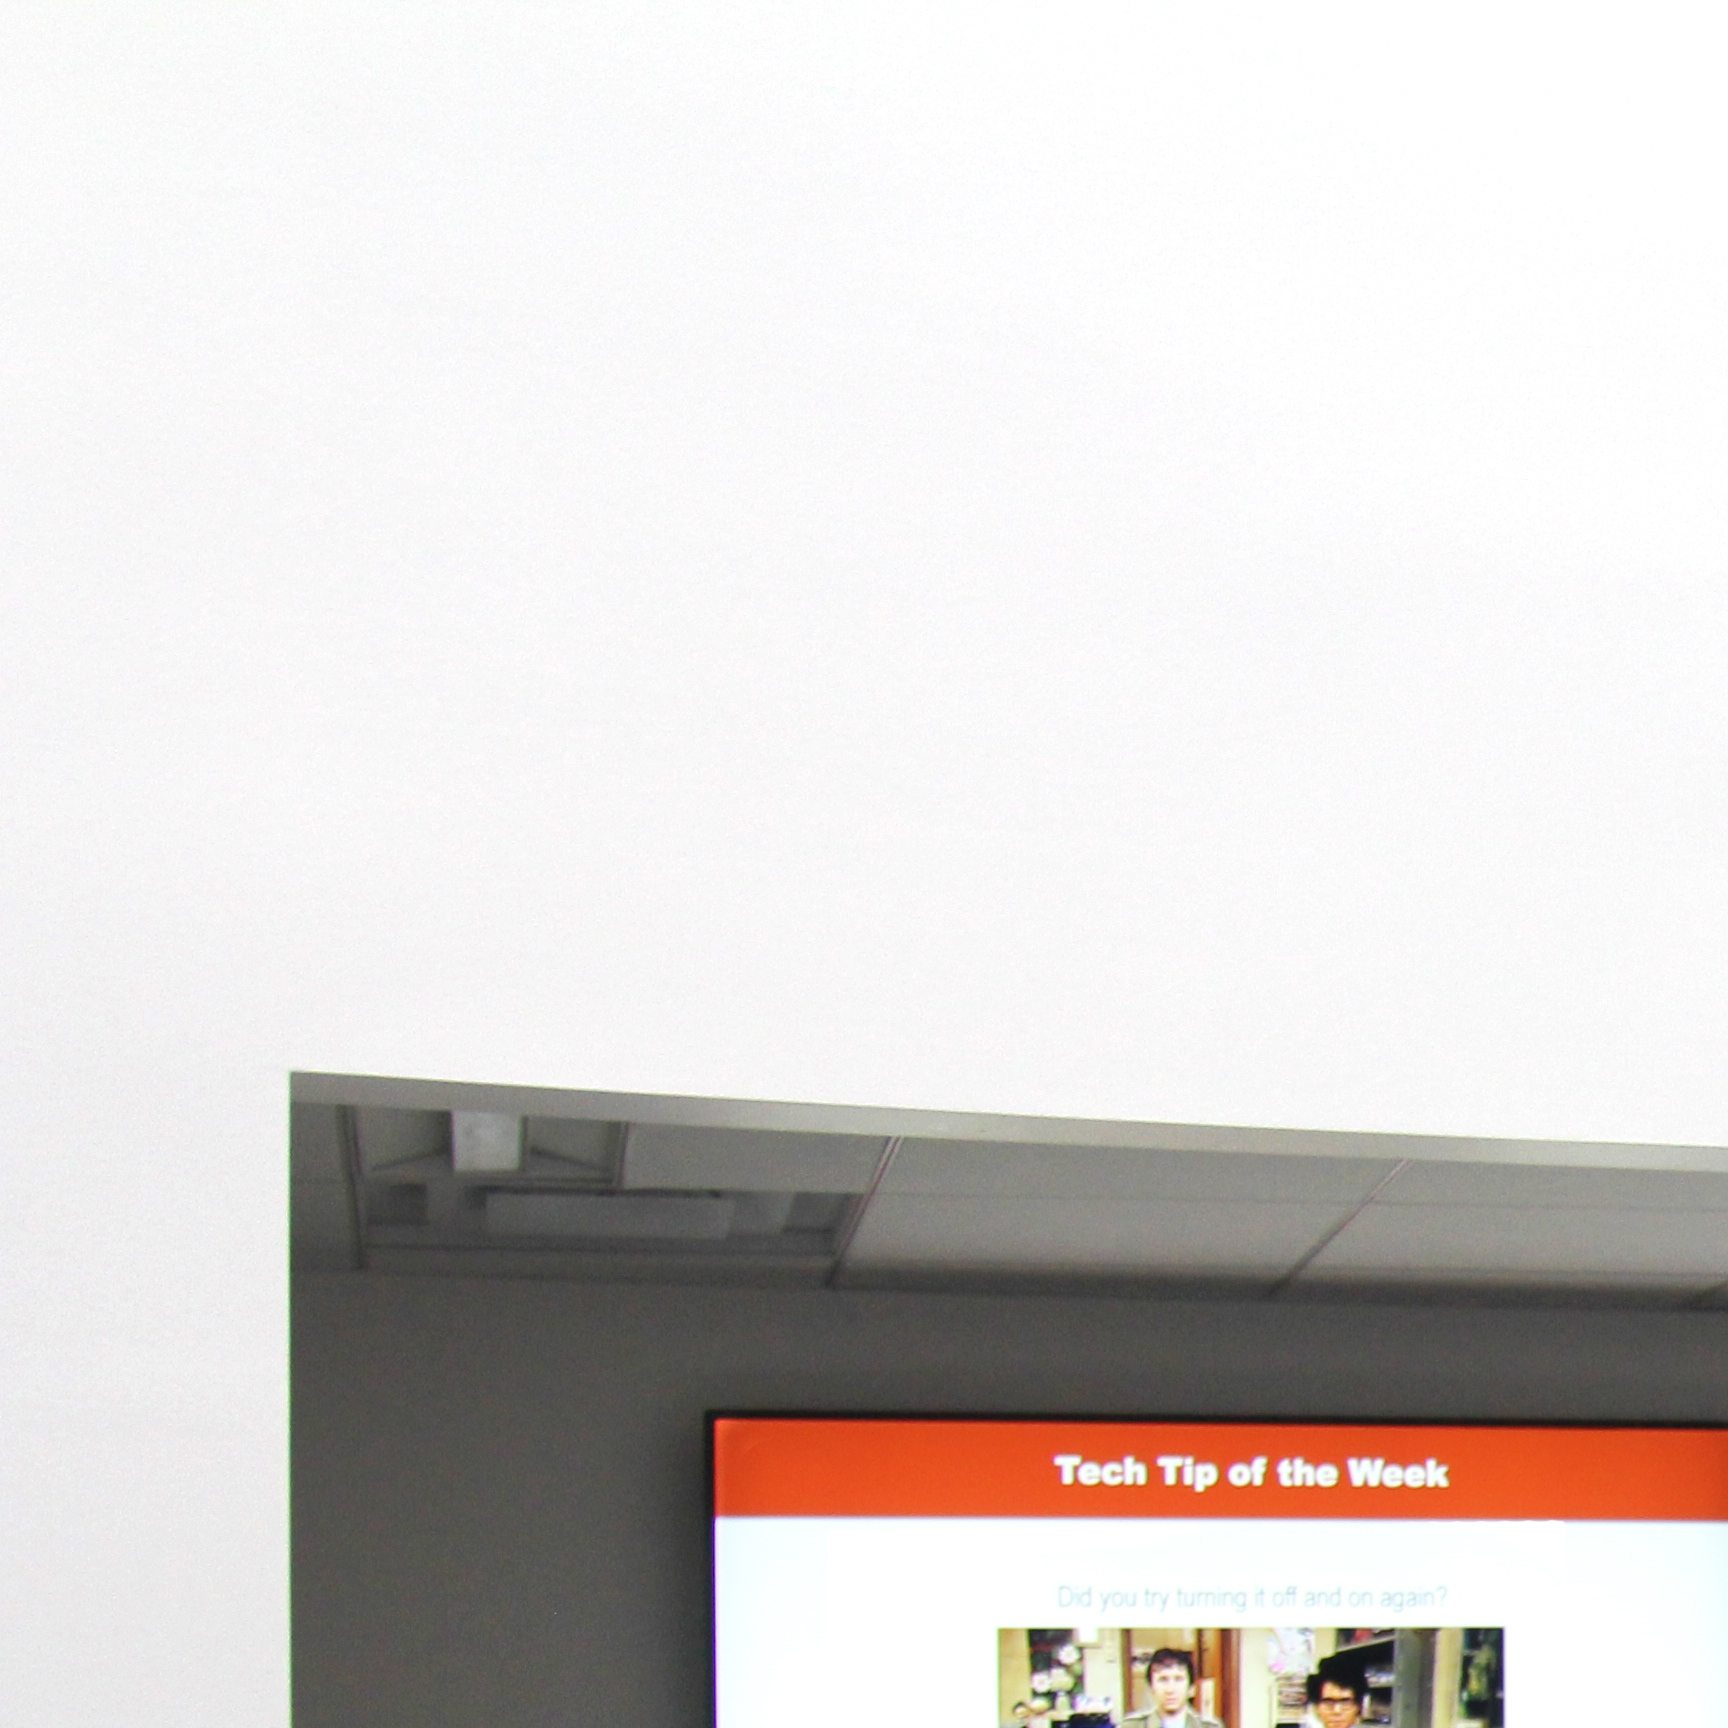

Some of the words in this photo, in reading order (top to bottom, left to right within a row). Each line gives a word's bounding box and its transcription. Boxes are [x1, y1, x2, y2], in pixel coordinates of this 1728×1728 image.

[1052, 1454, 1147, 1486] Tech
[1155, 1455, 1219, 1492] Tip
[1226, 1455, 1268, 1487] of
[1275, 1456, 1339, 1488] the
[1346, 1457, 1450, 1488] Week
[1057, 1585, 1093, 1609] Did
[1100, 1590, 1138, 1613] you
[1144, 1588, 1171, 1613] try
[1176, 1586, 1248, 1614] turning
[1254, 1586, 1266, 1608] it
[1272, 1585, 1298, 1608] off
[1304, 1586, 1343, 1608] and
[1348, 1590, 1374, 1608] on
[1380, 1585, 1449, 1614] again?
